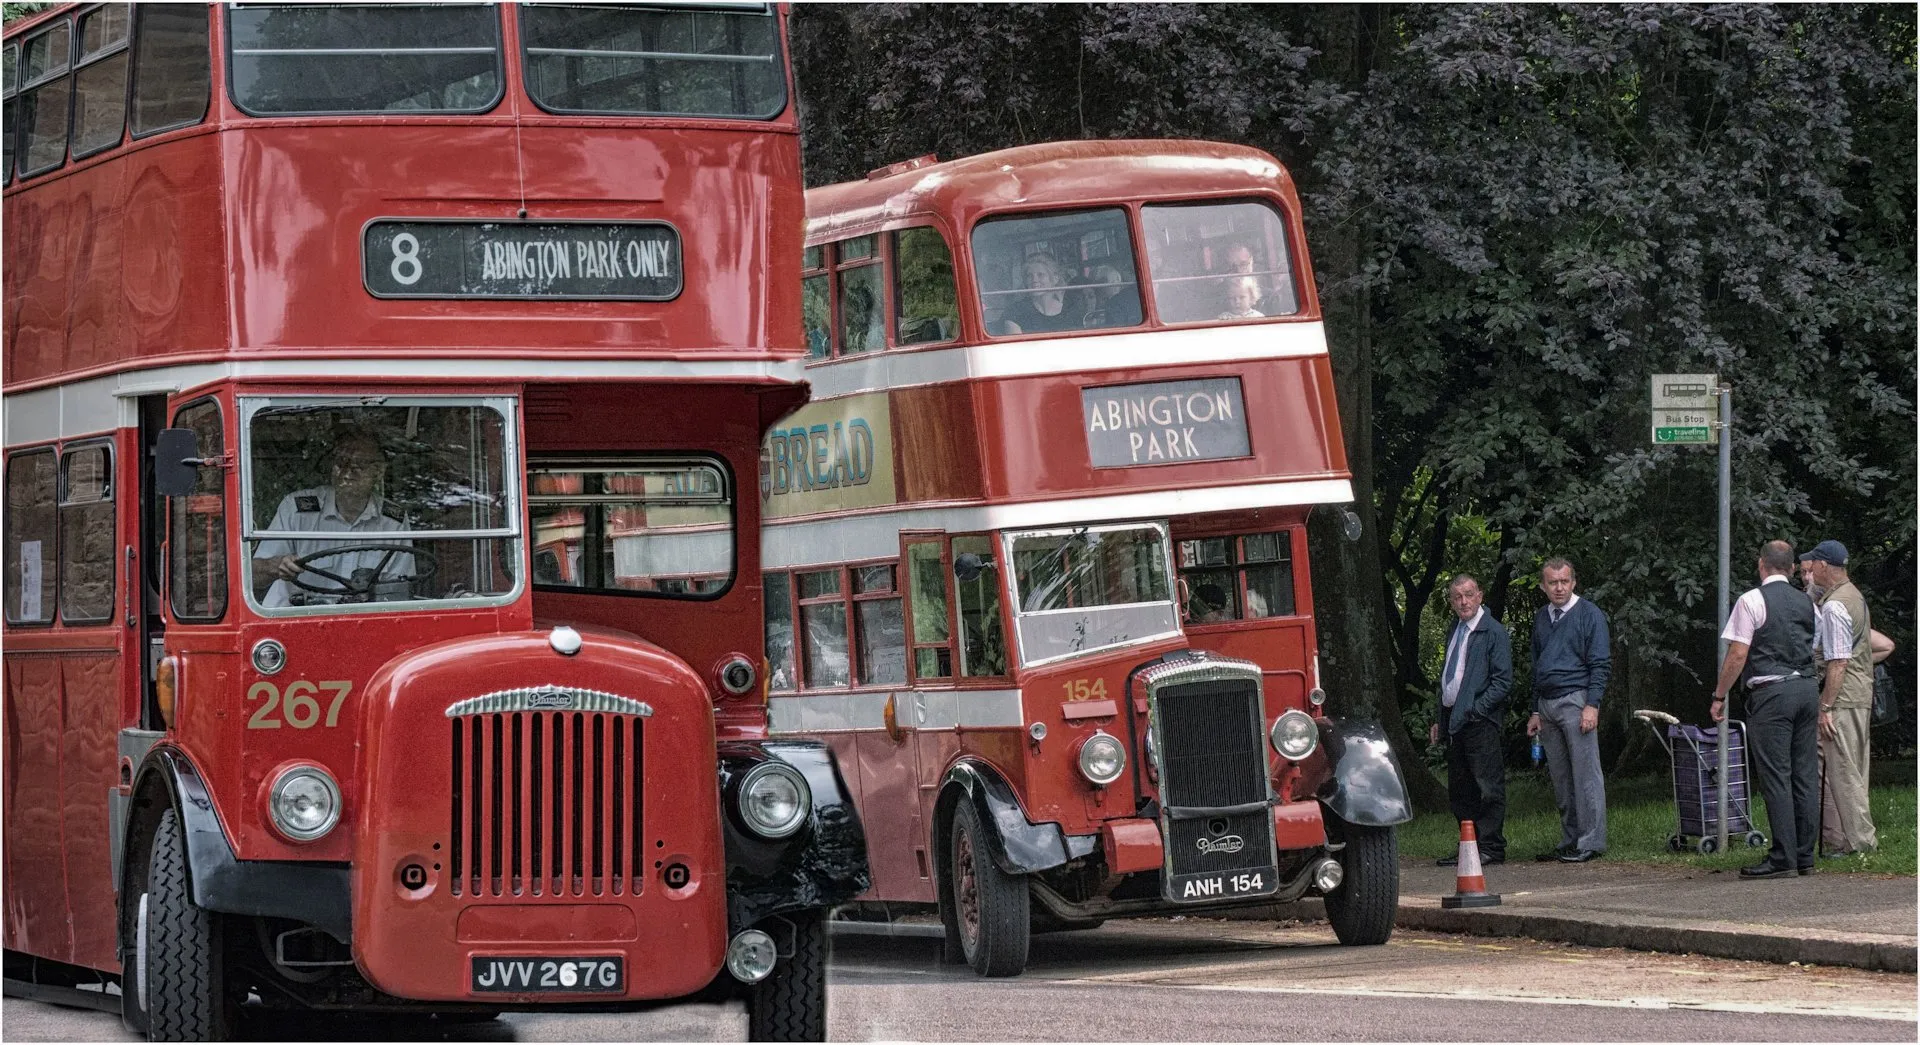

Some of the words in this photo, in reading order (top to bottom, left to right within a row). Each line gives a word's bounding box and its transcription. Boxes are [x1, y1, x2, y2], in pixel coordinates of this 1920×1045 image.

[390, 232, 423, 285] 8
[482, 240, 570, 281] ABINGTON
[577, 240, 624, 279] PARK
[627, 239, 670, 278] ONLY
[1090, 389, 1233, 432] ABINGTON
[1665, 415, 1681, 423] Bus
[1684, 415, 1705, 424] Stop
[770, 417, 874, 496] BREAD
[1129, 427, 1200, 462] PARK
[246, 680, 353, 729] 267
[1062, 677, 1108, 702] 154
[1196, 834, 1245, 856] Daimler
[1183, 877, 1223, 898] ANH
[1230, 873, 1264, 892] 154
[477, 961, 535, 987] JVV
[540, 961, 617, 987] 267G
